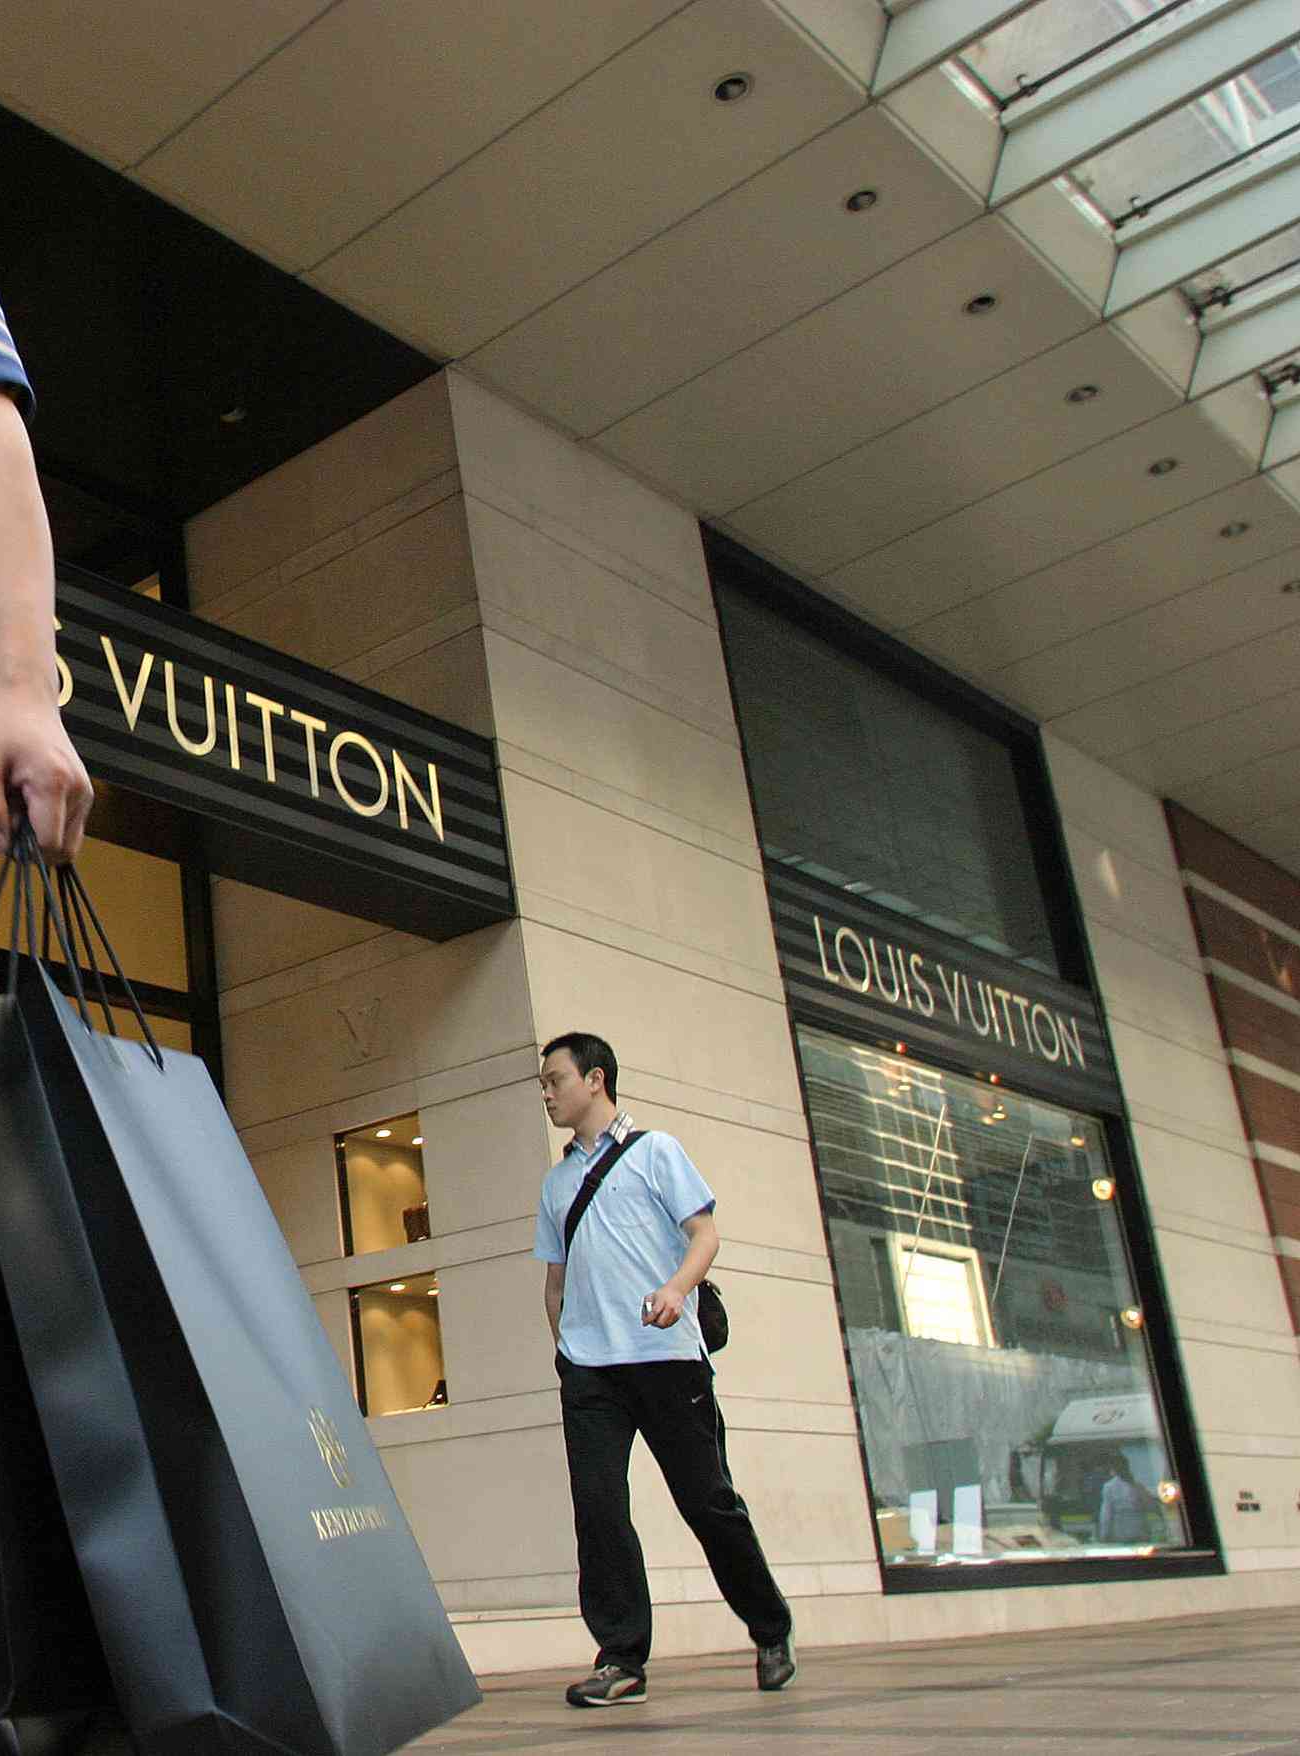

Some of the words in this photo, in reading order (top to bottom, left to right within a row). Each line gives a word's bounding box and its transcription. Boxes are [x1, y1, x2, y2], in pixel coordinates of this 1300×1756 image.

[101, 636, 444, 842] VUITTON
[813, 915, 936, 1018] LOUIS
[936, 964, 1086, 1070] VUITTON
